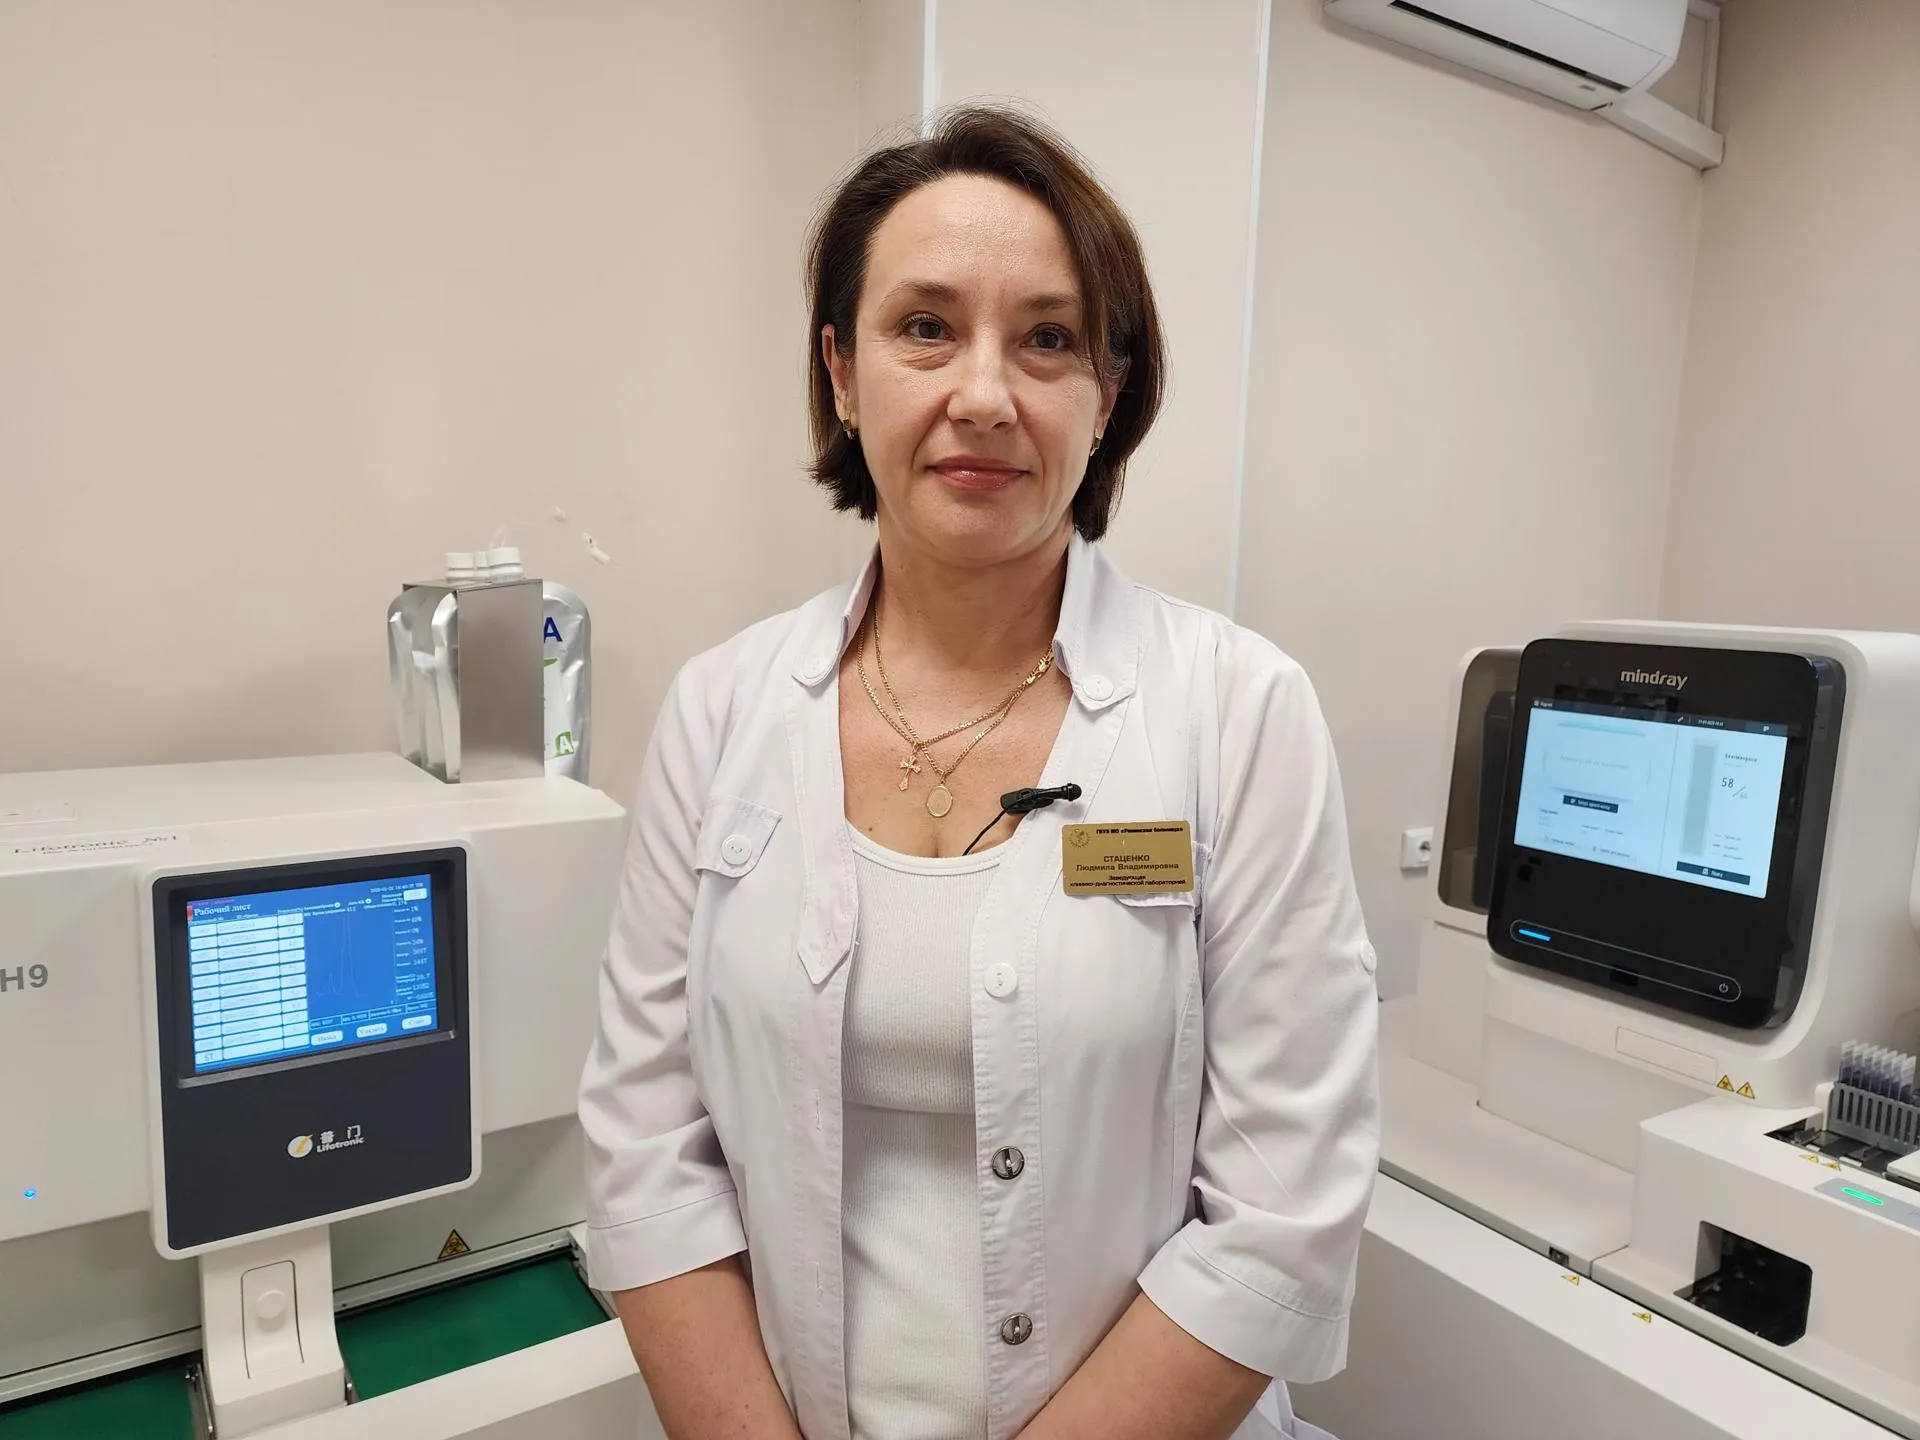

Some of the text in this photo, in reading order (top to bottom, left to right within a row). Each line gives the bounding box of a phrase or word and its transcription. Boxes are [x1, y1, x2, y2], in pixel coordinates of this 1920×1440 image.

[1620, 668, 1688, 690] mindray
[1721, 777, 1734, 788] 58
[1103, 855, 1150, 863] СТАЦЕНКО
[1076, 863, 1179, 872] Людмила Владимировна
[194, 904, 251, 916] Рабочий лист
[0, 964, 48, 992] H9
[316, 1137, 365, 1153] Lifotronic
